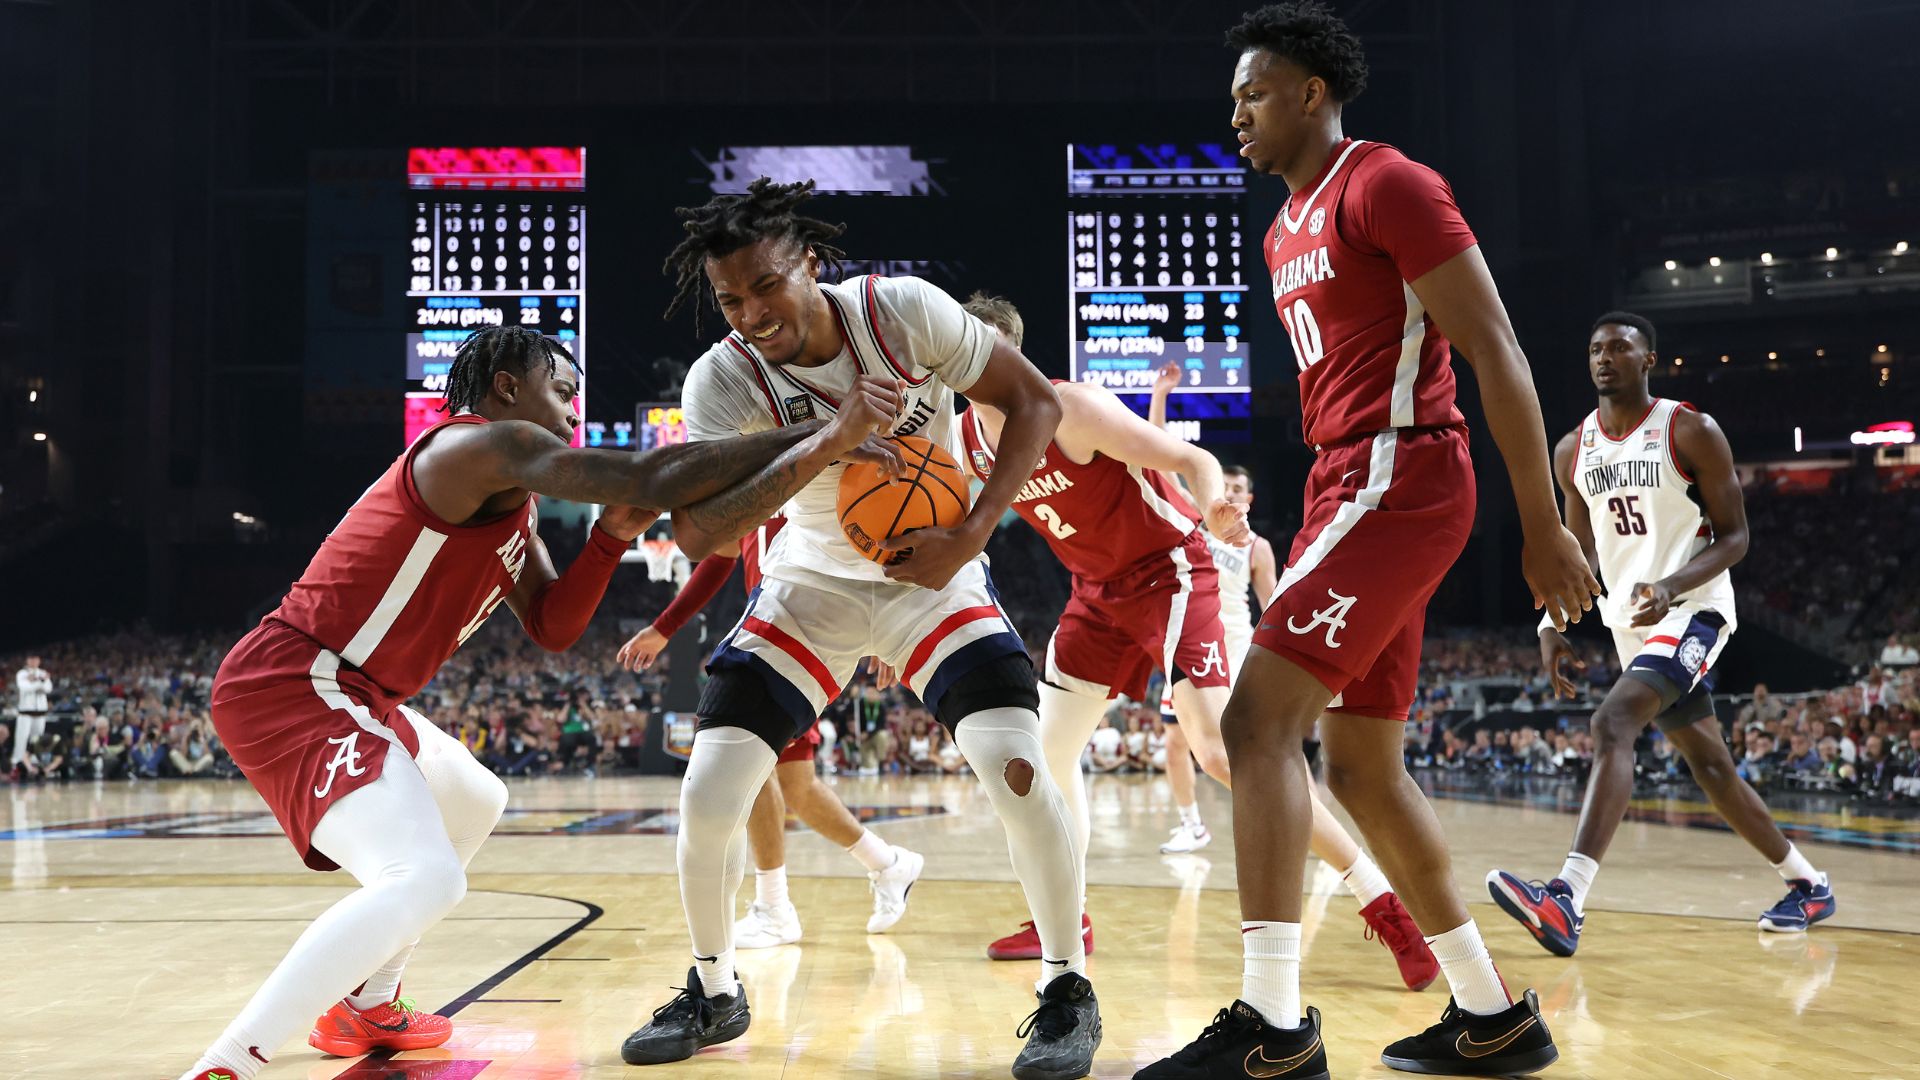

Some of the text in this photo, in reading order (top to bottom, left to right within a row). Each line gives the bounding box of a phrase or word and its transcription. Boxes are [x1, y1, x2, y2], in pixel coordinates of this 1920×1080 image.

[416, 217, 427, 232] 2
[495, 217, 507, 232] 0
[519, 217, 531, 232] 0
[543, 217, 555, 232] 0
[411, 236, 580, 252] 10 0 1 1 0 0 0
[1109, 232, 1121, 248] 9
[1133, 232, 1145, 248] 4
[1158, 232, 1167, 248] 1
[1181, 232, 1194, 248] 0
[1206, 232, 1215, 248] 1
[1230, 232, 1241, 248] 2
[446, 256, 458, 272] 6
[470, 256, 483, 272] 0
[495, 256, 507, 272] 0
[519, 256, 529, 272] 1
[543, 256, 553, 272] 1
[567, 256, 580, 272] 0
[1109, 252, 1121, 267] 9
[1133, 252, 1146, 267] 4
[1158, 252, 1169, 267] 2
[1182, 252, 1191, 267] 1
[1206, 252, 1218, 267] 0
[1231, 252, 1240, 267] 1
[519, 275, 529, 291] 1
[543, 275, 555, 291] 0
[568, 275, 577, 291] 1
[1134, 271, 1144, 287] 1
[1158, 271, 1170, 287] 0
[1182, 271, 1194, 287] 0
[1207, 271, 1216, 287] 1
[1231, 271, 1240, 287] 1
[520, 308, 540, 324] 22
[560, 308, 573, 323] 4
[1224, 303, 1238, 319] 4
[1283, 299, 1324, 372] 10
[1584, 460, 1661, 496] CONNECTICUT
[1034, 503, 1077, 540] 2
[1608, 495, 1647, 536] 35
[1287, 588, 1358, 649] A
[1191, 641, 1226, 678] A
[314, 731, 366, 798] A
